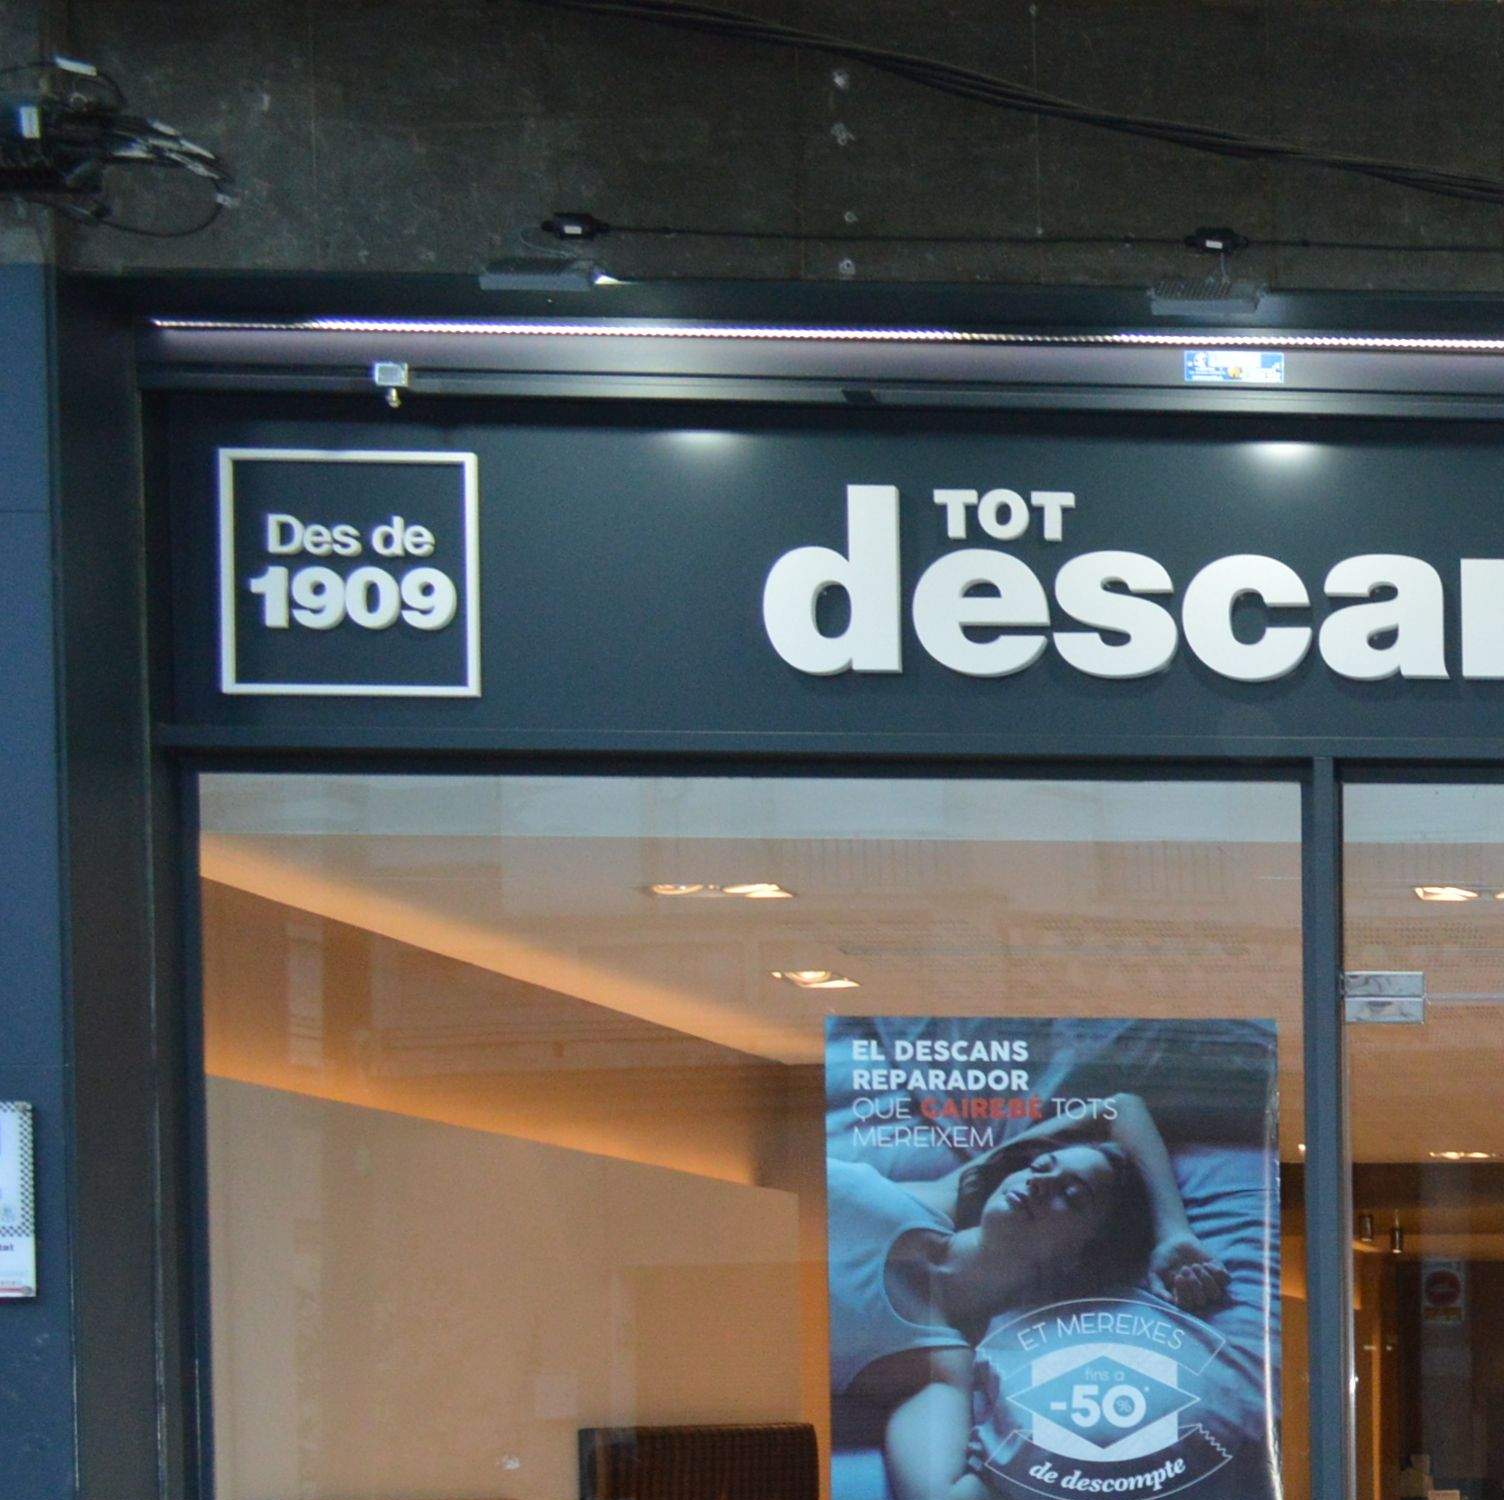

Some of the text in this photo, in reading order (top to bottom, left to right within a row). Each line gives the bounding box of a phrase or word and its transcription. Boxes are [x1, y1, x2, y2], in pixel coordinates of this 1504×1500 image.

[933, 488, 1075, 542] TOT
[266, 514, 436, 558] Des de
[250, 566, 457, 631] 1909
[852, 1039, 1029, 1062] EL DESCANS
[852, 1069, 1029, 1092] REPARADOR
[852, 1097, 912, 1121] QUE
[1051, 1098, 1118, 1120] TOTS
[852, 1126, 994, 1148] MEREIXEM
[1017, 1312, 1186, 1352] ET MEREIXES
[1084, 1367, 1125, 1382] fins a
[1028, 1457, 1187, 1493] de descompte
